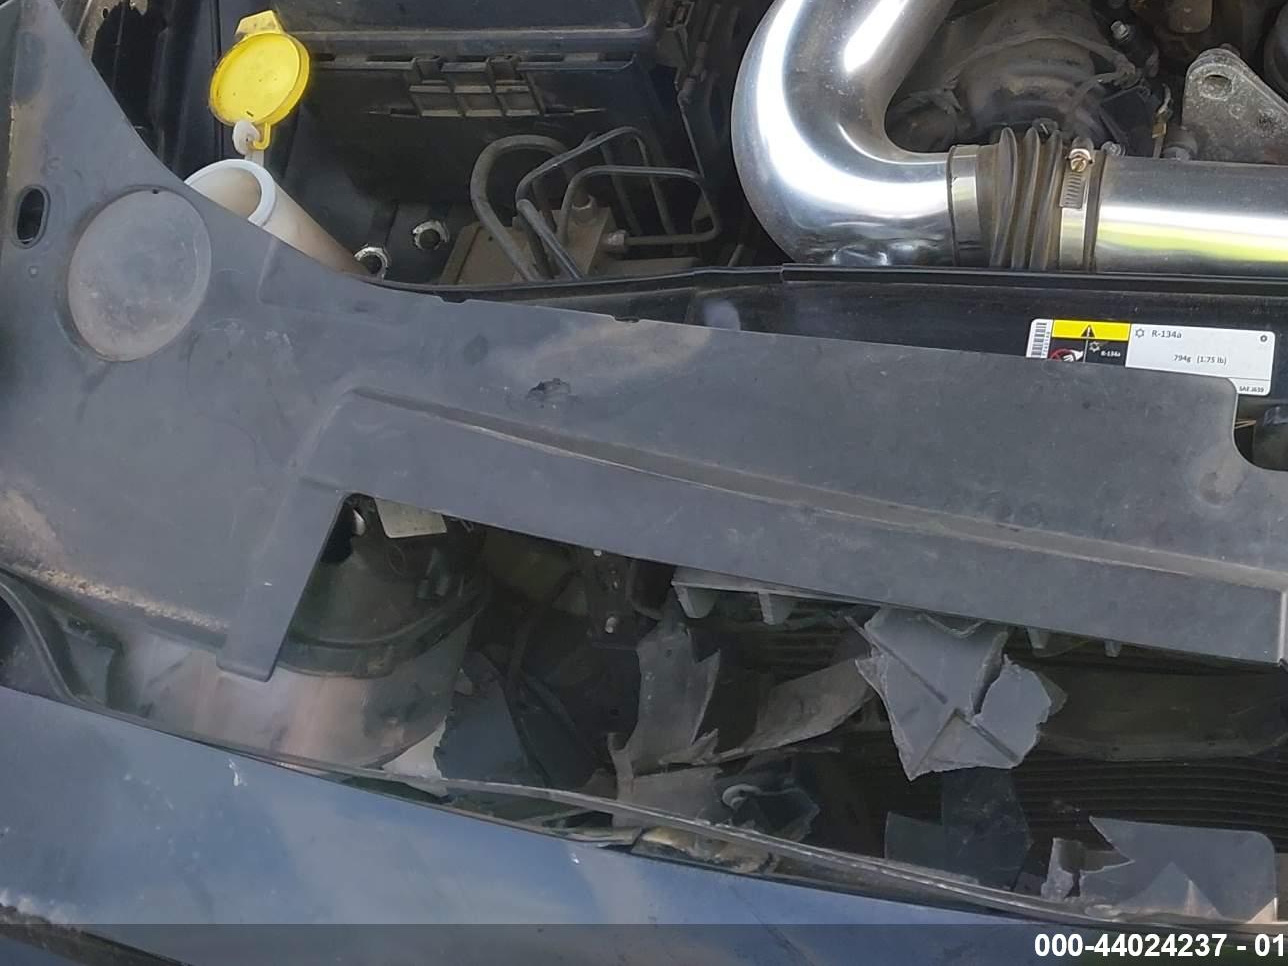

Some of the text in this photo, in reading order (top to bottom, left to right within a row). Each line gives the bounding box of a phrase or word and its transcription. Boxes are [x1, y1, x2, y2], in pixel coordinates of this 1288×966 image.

[1151, 330, 1182, 339] R-134a
[1174, 354, 1227, 366] 794g (1.75 lb)
